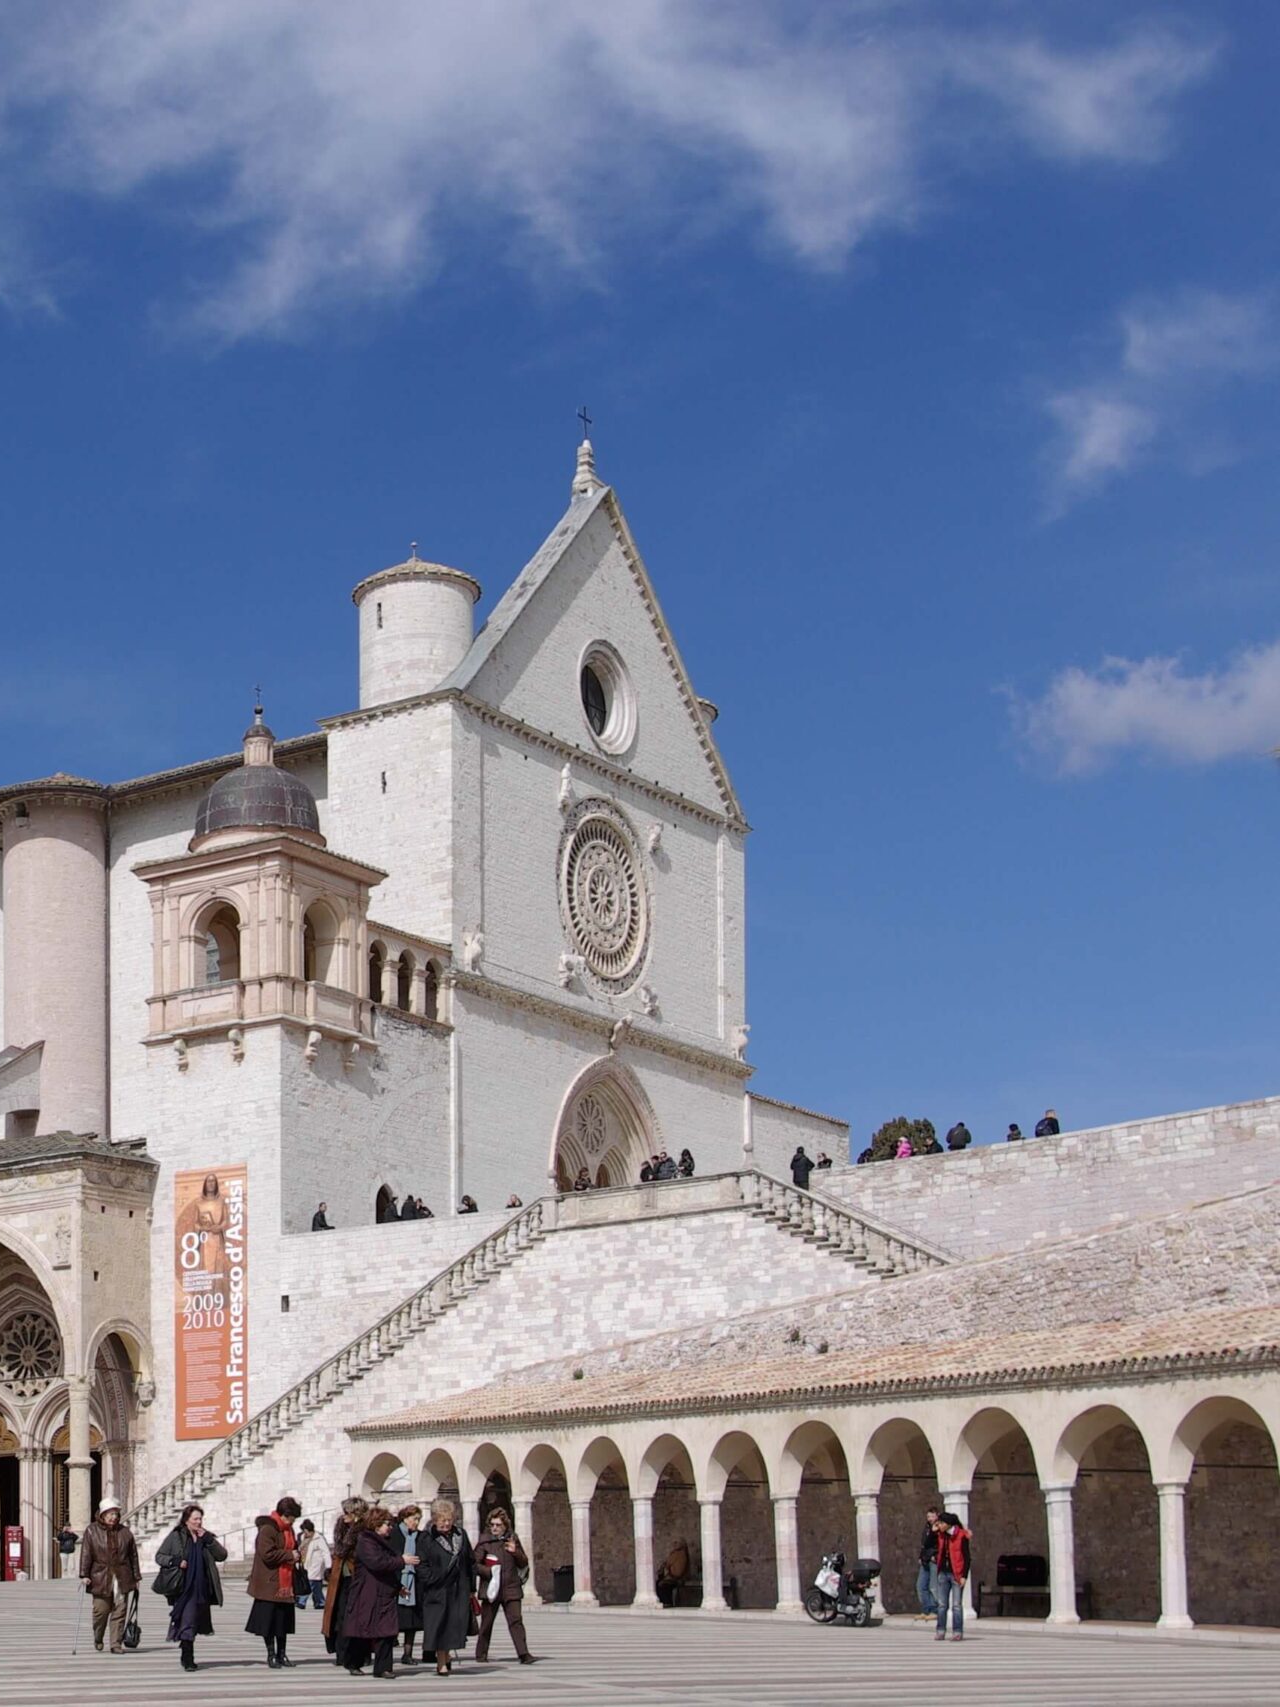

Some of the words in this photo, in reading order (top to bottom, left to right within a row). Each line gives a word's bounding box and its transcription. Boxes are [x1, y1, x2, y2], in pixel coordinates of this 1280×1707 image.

[183, 1292, 224, 1313] 2009
[182, 1310, 225, 1330] 2010
[226, 1265, 243, 1377] Francesco
[226, 1381, 243, 1424] San
